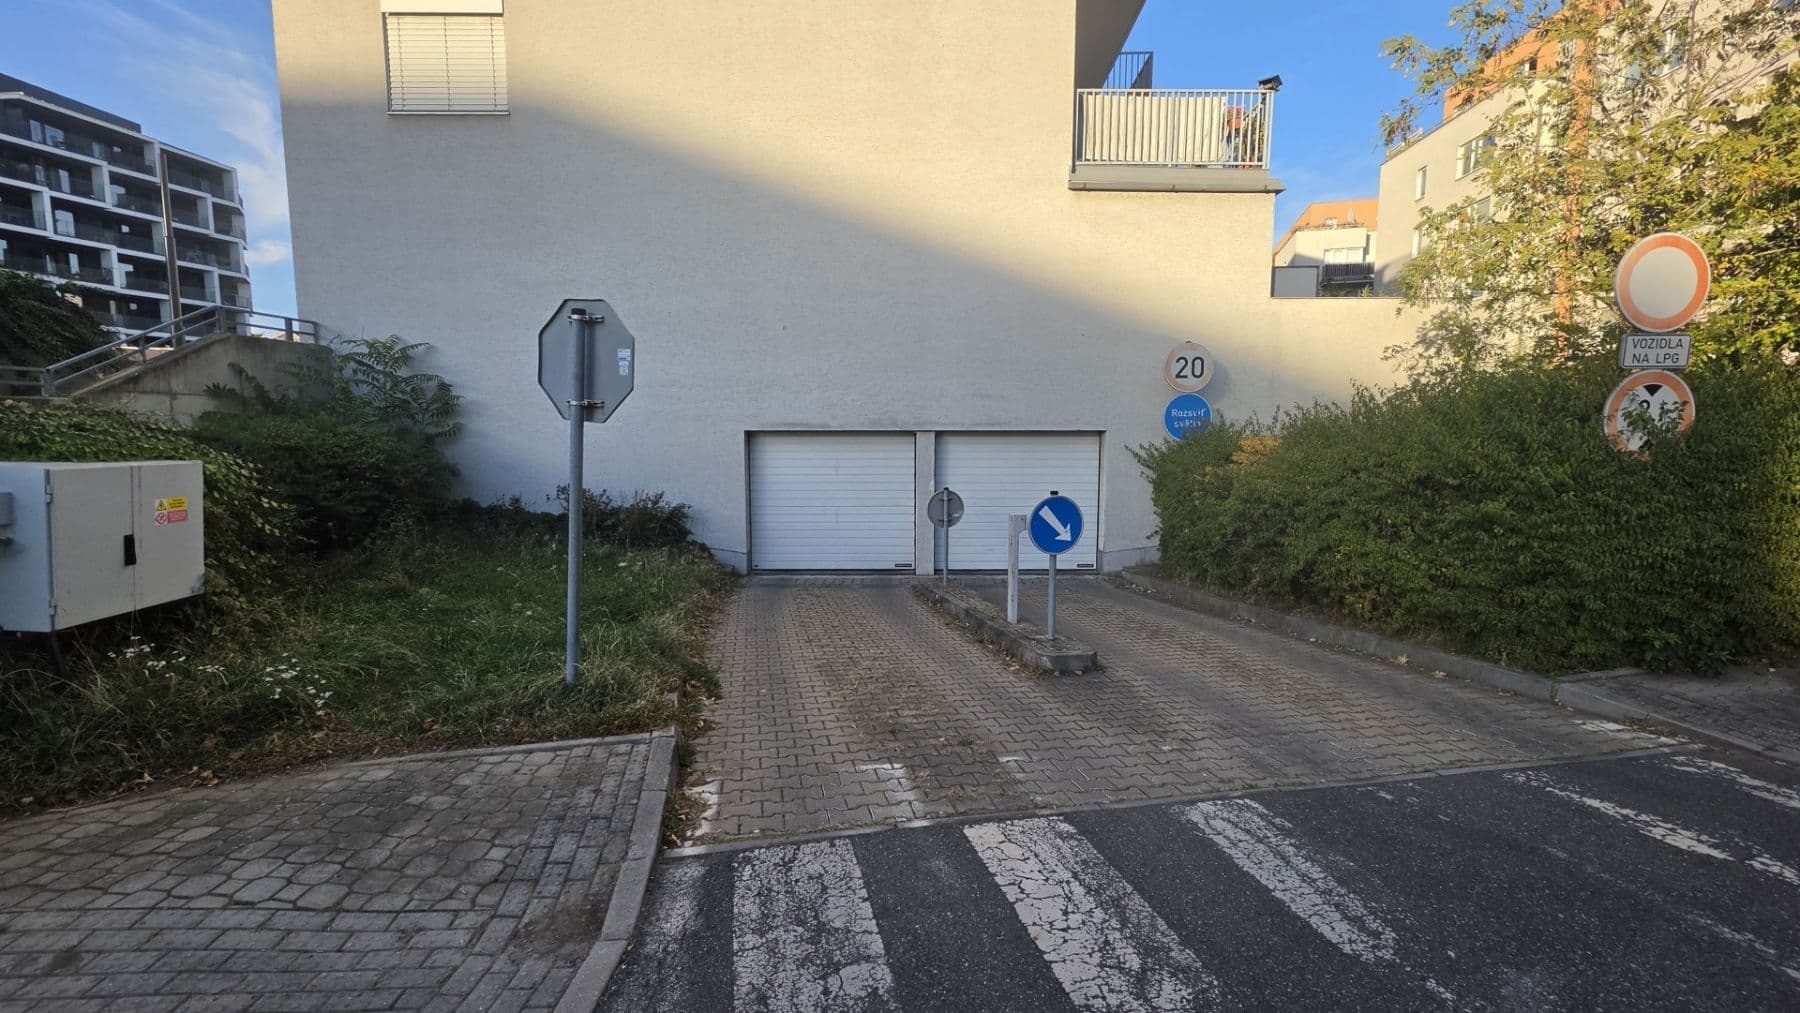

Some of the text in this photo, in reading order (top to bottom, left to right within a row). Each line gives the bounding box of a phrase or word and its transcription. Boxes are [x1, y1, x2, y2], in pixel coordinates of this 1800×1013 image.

[1632, 338, 1683, 349] VOZIDLA
[1632, 353, 1680, 364] NA LPG
[1175, 356, 1205, 379] 20
